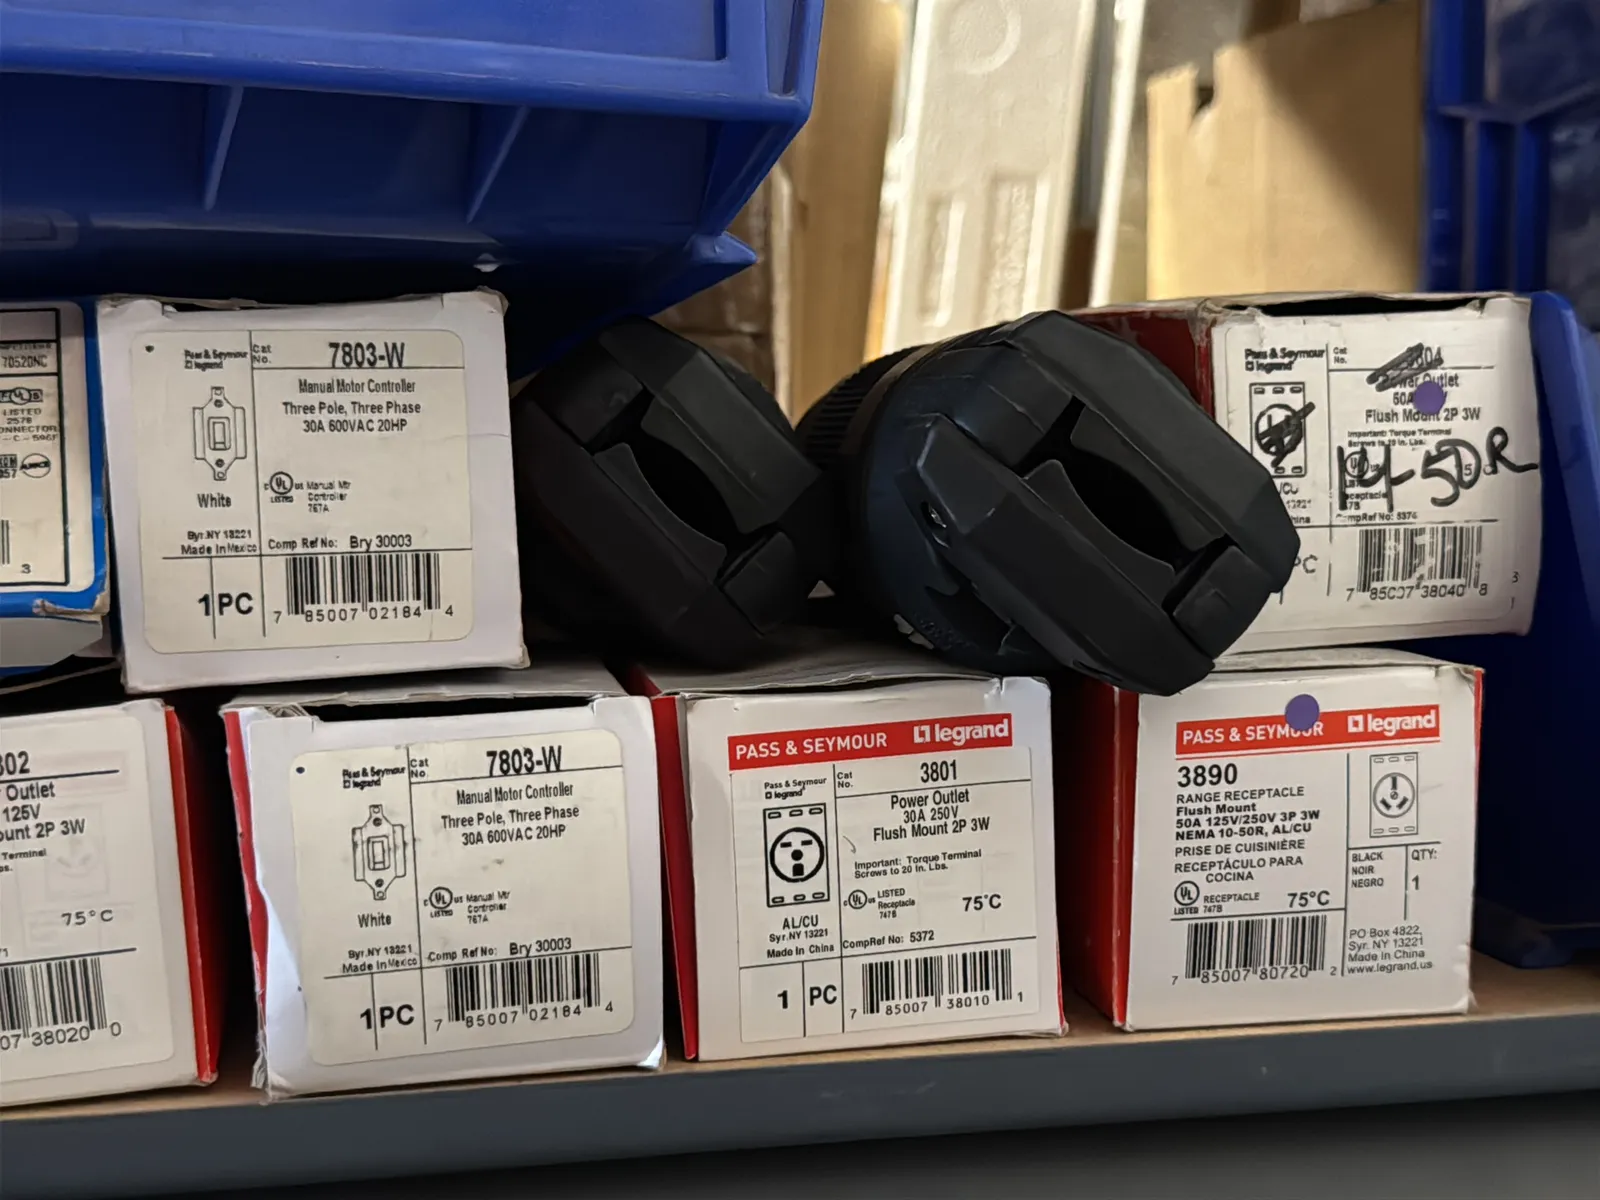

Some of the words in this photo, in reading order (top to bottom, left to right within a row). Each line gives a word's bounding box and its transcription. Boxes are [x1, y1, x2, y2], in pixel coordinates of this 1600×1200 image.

[328, 342, 405, 368] 7803-W
[299, 378, 334, 393] Manual
[336, 379, 365, 393] Motor
[367, 378, 416, 393] Controller
[282, 401, 316, 415] Three
[318, 400, 348, 416] Pole,
[351, 401, 383, 414] Three
[386, 400, 421, 414] Phase
[1365, 409, 1399, 424] Flush
[1443, 408, 1459, 421] 2P
[1462, 407, 1481, 421] 3W
[303, 420, 325, 432] 30A
[329, 419, 374, 432] 600VAC
[378, 419, 408, 432] 20HP
[1337, 426, 1539, 513] 14-50R
[197, 492, 232, 508] White
[181, 544, 212, 555] Made
[269, 538, 297, 551] Comp
[302, 537, 319, 549] Ref
[321, 537, 338, 548] No:
[349, 536, 372, 552] Bry
[376, 534, 412, 547] 30003
[21, 564, 31, 574] 3
[1421, 584, 1465, 598] 38040
[1479, 584, 1488, 596] 8
[198, 593, 211, 616] 1
[218, 592, 254, 616] PC
[273, 611, 282, 624] 7
[305, 608, 358, 622] 85007
[369, 606, 422, 619] 02184
[445, 605, 454, 616] 4
[1367, 709, 1436, 736] legrand
[935, 719, 1009, 746] legrand
[1182, 727, 1225, 745] PASS
[1229, 727, 1241, 742] &
[736, 741, 781, 760] PASS
[785, 739, 798, 755] &
[803, 733, 888, 754] SEYMOUR
[410, 758, 428, 768] Cat
[486, 745, 562, 777] 7803-W
[920, 759, 957, 783] 3801
[1177, 763, 1238, 787] 3890
[6, 782, 56, 801] Outlet
[764, 782, 783, 790] Pass
[792, 778, 827, 790] Seymour
[457, 788, 492, 805] Manual
[495, 787, 522, 802] Motor
[525, 782, 573, 799] Controller
[774, 790, 802, 800] legrand
[891, 794, 929, 809] Power
[932, 788, 970, 805] Outlet
[1177, 792, 1220, 804] RANGE
[1224, 787, 1305, 801] RECEPTACLE
[3, 804, 41, 822] 125V
[441, 815, 474, 829] Three
[477, 812, 505, 826] Pole,
[508, 809, 541, 822] Three
[544, 806, 580, 819] Phase
[903, 809, 926, 823] 30A
[931, 806, 959, 821] 250V
[1176, 805, 1211, 816] Flush
[1216, 803, 1256, 814] Mount
[1176, 819, 1201, 828] 50A
[1206, 813, 1276, 826] 125V/250V
[1280, 812, 1296, 822] 3P
[1300, 810, 1320, 821] 3W
[35, 822, 55, 839] 2P
[60, 819, 85, 835] 3W
[461, 832, 483, 846] 30A
[487, 827, 533, 843] 600VAC
[536, 824, 566, 840] 20HP
[873, 826, 907, 841] Flush
[912, 823, 948, 838] Mount
[952, 819, 966, 833] 2P
[971, 817, 990, 831] 3W
[1176, 829, 1215, 841] NEMA
[1219, 826, 1268, 838] 10-50R,
[1272, 823, 1312, 834] AL/CU
[1, 848, 47, 860] Terminal
[1175, 846, 1211, 857] PRISE
[1215, 844, 1231, 854] DE
[1235, 839, 1305, 853] CUISINIÈRE
[1412, 848, 1437, 860] QTY:
[854, 858, 901, 870] Important:
[907, 854, 939, 865] Torque
[941, 849, 982, 861] Terminal
[1175, 858, 1266, 873] RECEPTÁCULO
[1269, 856, 1303, 866] PARA
[1352, 852, 1383, 862] BLACK
[854, 868, 887, 878] Screws
[890, 867, 900, 875] to
[902, 866, 912, 874] 20
[928, 862, 948, 871] Lbs.
[1206, 872, 1254, 883] COCINA
[1352, 866, 1374, 875] NOIR
[1351, 878, 1384, 888] NEGRO
[1412, 874, 1420, 890] 1
[466, 893, 494, 902] Manual
[878, 888, 905, 898] LISTED
[1203, 892, 1260, 903] RECEPTACLE
[1287, 890, 1330, 908] 75°C
[878, 898, 916, 910] Receptacle
[962, 894, 1002, 912] 75°C
[358, 912, 392, 928] White
[782, 915, 819, 930] AL/CU
[804, 928, 828, 939] 13221
[888, 936, 903, 945] No:
[910, 930, 934, 943] 5372
[1349, 929, 1366, 938] PO
[1369, 928, 1390, 937] Box
[1392, 925, 1422, 935] 4822,
[428, 949, 457, 962] Comp
[462, 948, 479, 958] Ref
[481, 946, 497, 956] No:
[510, 942, 532, 957] Bry
[535, 937, 572, 951] 30003
[767, 948, 793, 958] Made
[809, 943, 834, 954] China
[1372, 940, 1388, 949] NY
[1393, 936, 1424, 948] 13221
[1348, 952, 1378, 962] Made
[1394, 949, 1425, 959] China
[342, 960, 373, 973] Made
[388, 958, 418, 968] Mexico
[1347, 961, 1433, 974] www.legrand.us
[1171, 976, 1178, 985] 7
[1201, 969, 1251, 983] 85007
[1259, 966, 1309, 980] 80720
[1330, 966, 1337, 976] 2
[777, 990, 788, 1009] 1
[809, 984, 837, 1006] PC
[850, 1008, 857, 1020] 7
[885, 1001, 928, 1016] 85007
[947, 995, 990, 1010] 38010
[1018, 992, 1023, 1002] 1
[360, 1008, 372, 1030] 1
[380, 1004, 415, 1028] PC
[434, 1019, 442, 1031] 7
[466, 1011, 518, 1028] 85007
[529, 1005, 581, 1021] 02184
[605, 1002, 613, 1012] 4
[31, 1026, 90, 1046] 38020
[110, 1022, 122, 1037] 0
